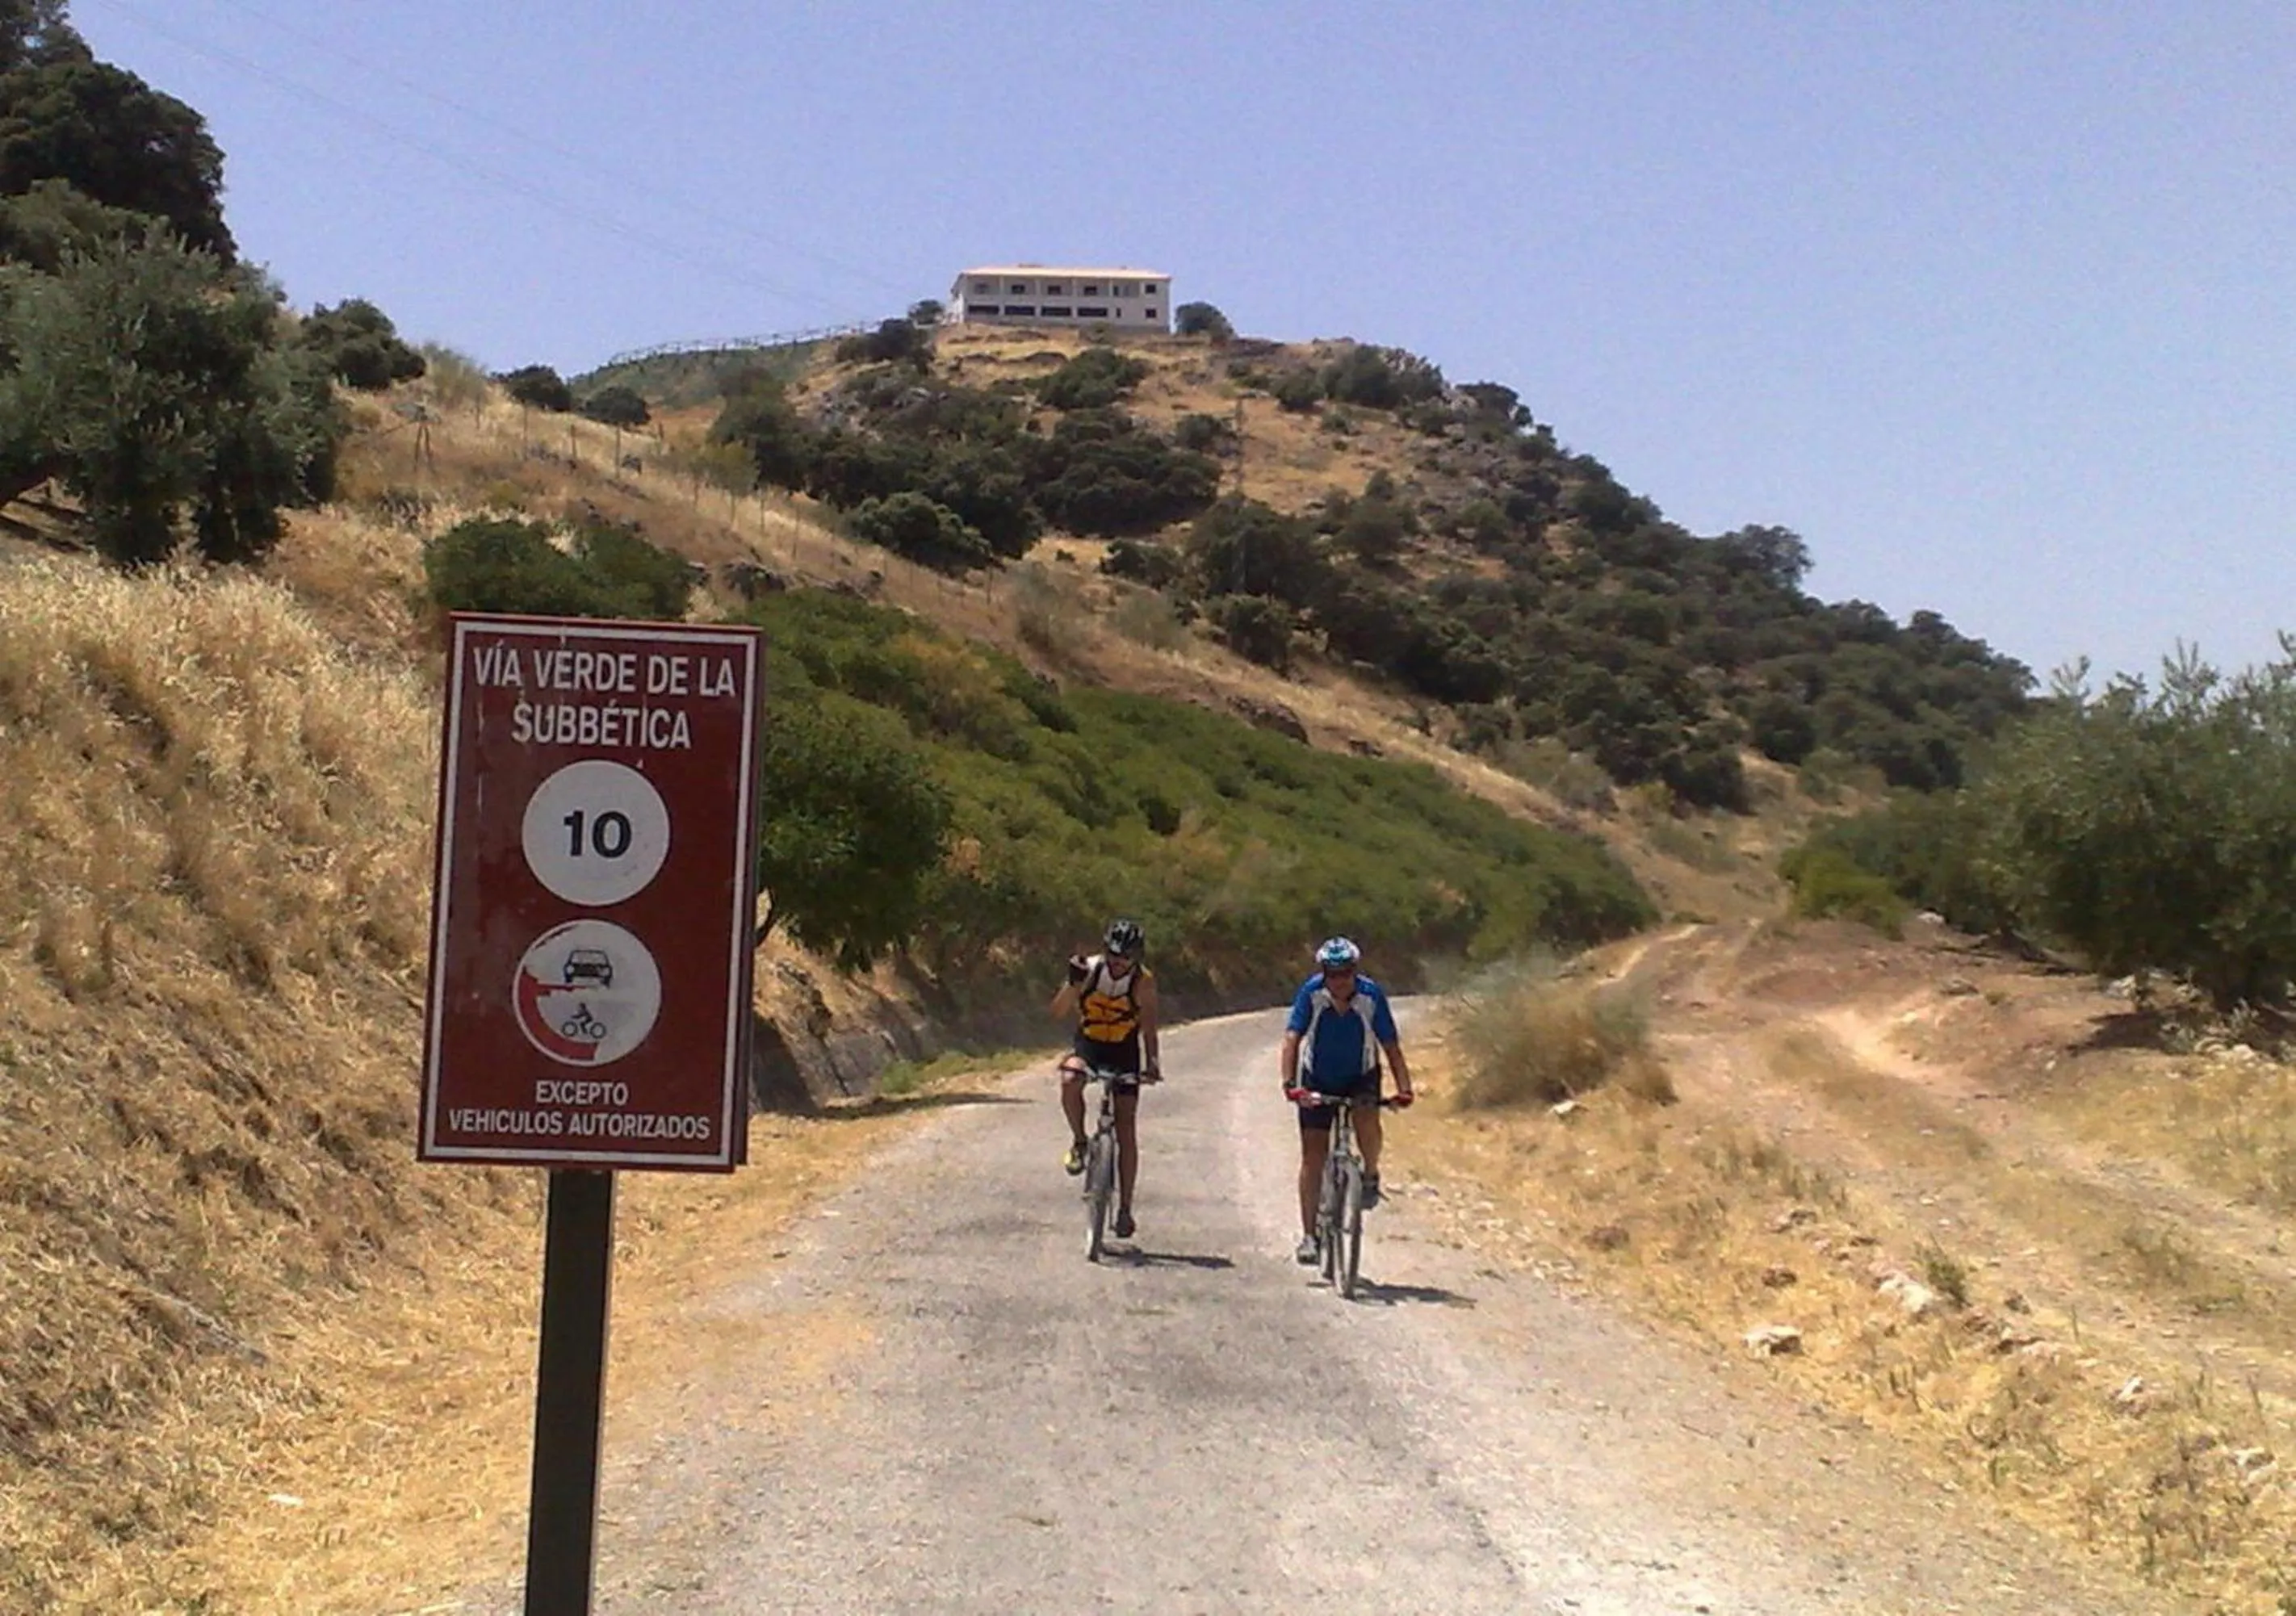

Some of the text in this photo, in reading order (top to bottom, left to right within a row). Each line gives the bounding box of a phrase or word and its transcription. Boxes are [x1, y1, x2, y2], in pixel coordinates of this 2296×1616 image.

[473, 638, 735, 697] VÍA VERDE DE LA
[512, 697, 691, 749] SUBBÉTICA
[563, 810, 631, 858] 10
[535, 1080, 629, 1106] EXCEPTO
[449, 1109, 710, 1140] VEHICULOS AUTORIZADOS
